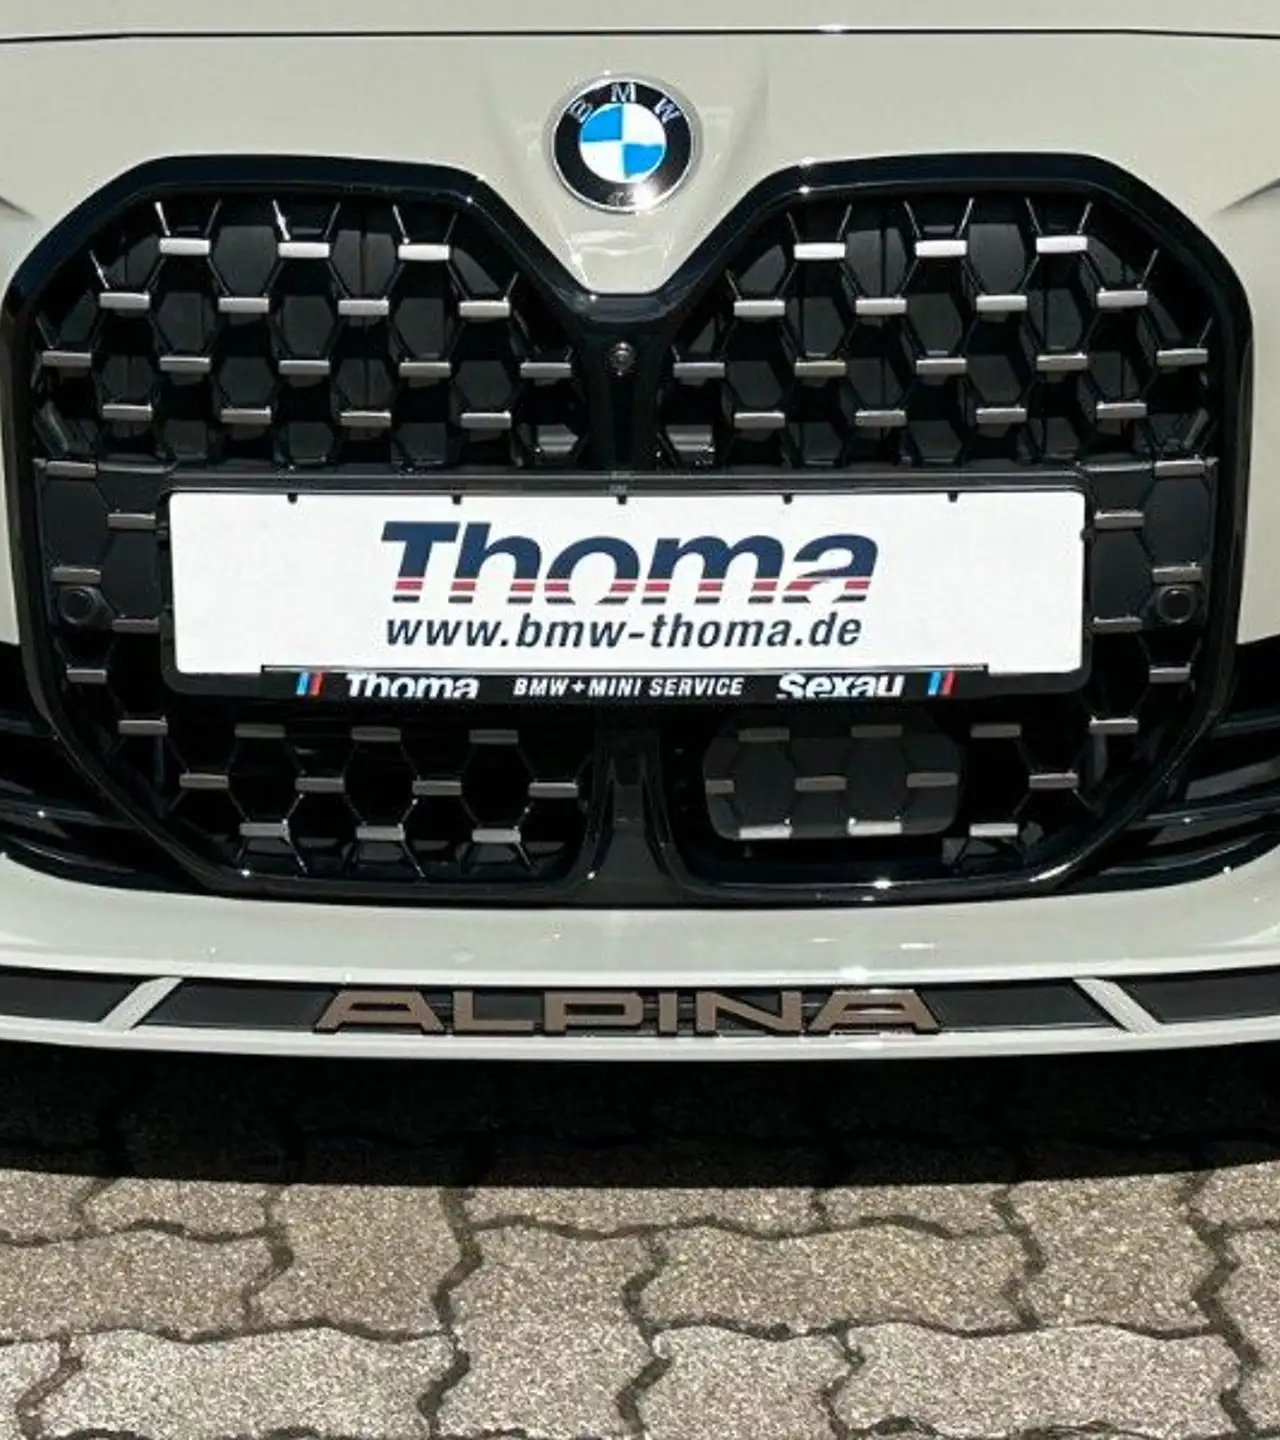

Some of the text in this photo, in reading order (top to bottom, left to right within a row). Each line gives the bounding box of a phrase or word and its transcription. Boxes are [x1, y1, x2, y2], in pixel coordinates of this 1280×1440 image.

[569, 82, 681, 123] BMW
[380, 520, 878, 604] Thoma
[386, 612, 862, 648] www.bmw-thoma.de
[346, 672, 479, 700] Thoma
[649, 676, 745, 697] SERVICE
[777, 672, 904, 700] Sexau
[314, 988, 942, 1036] ALPINA
